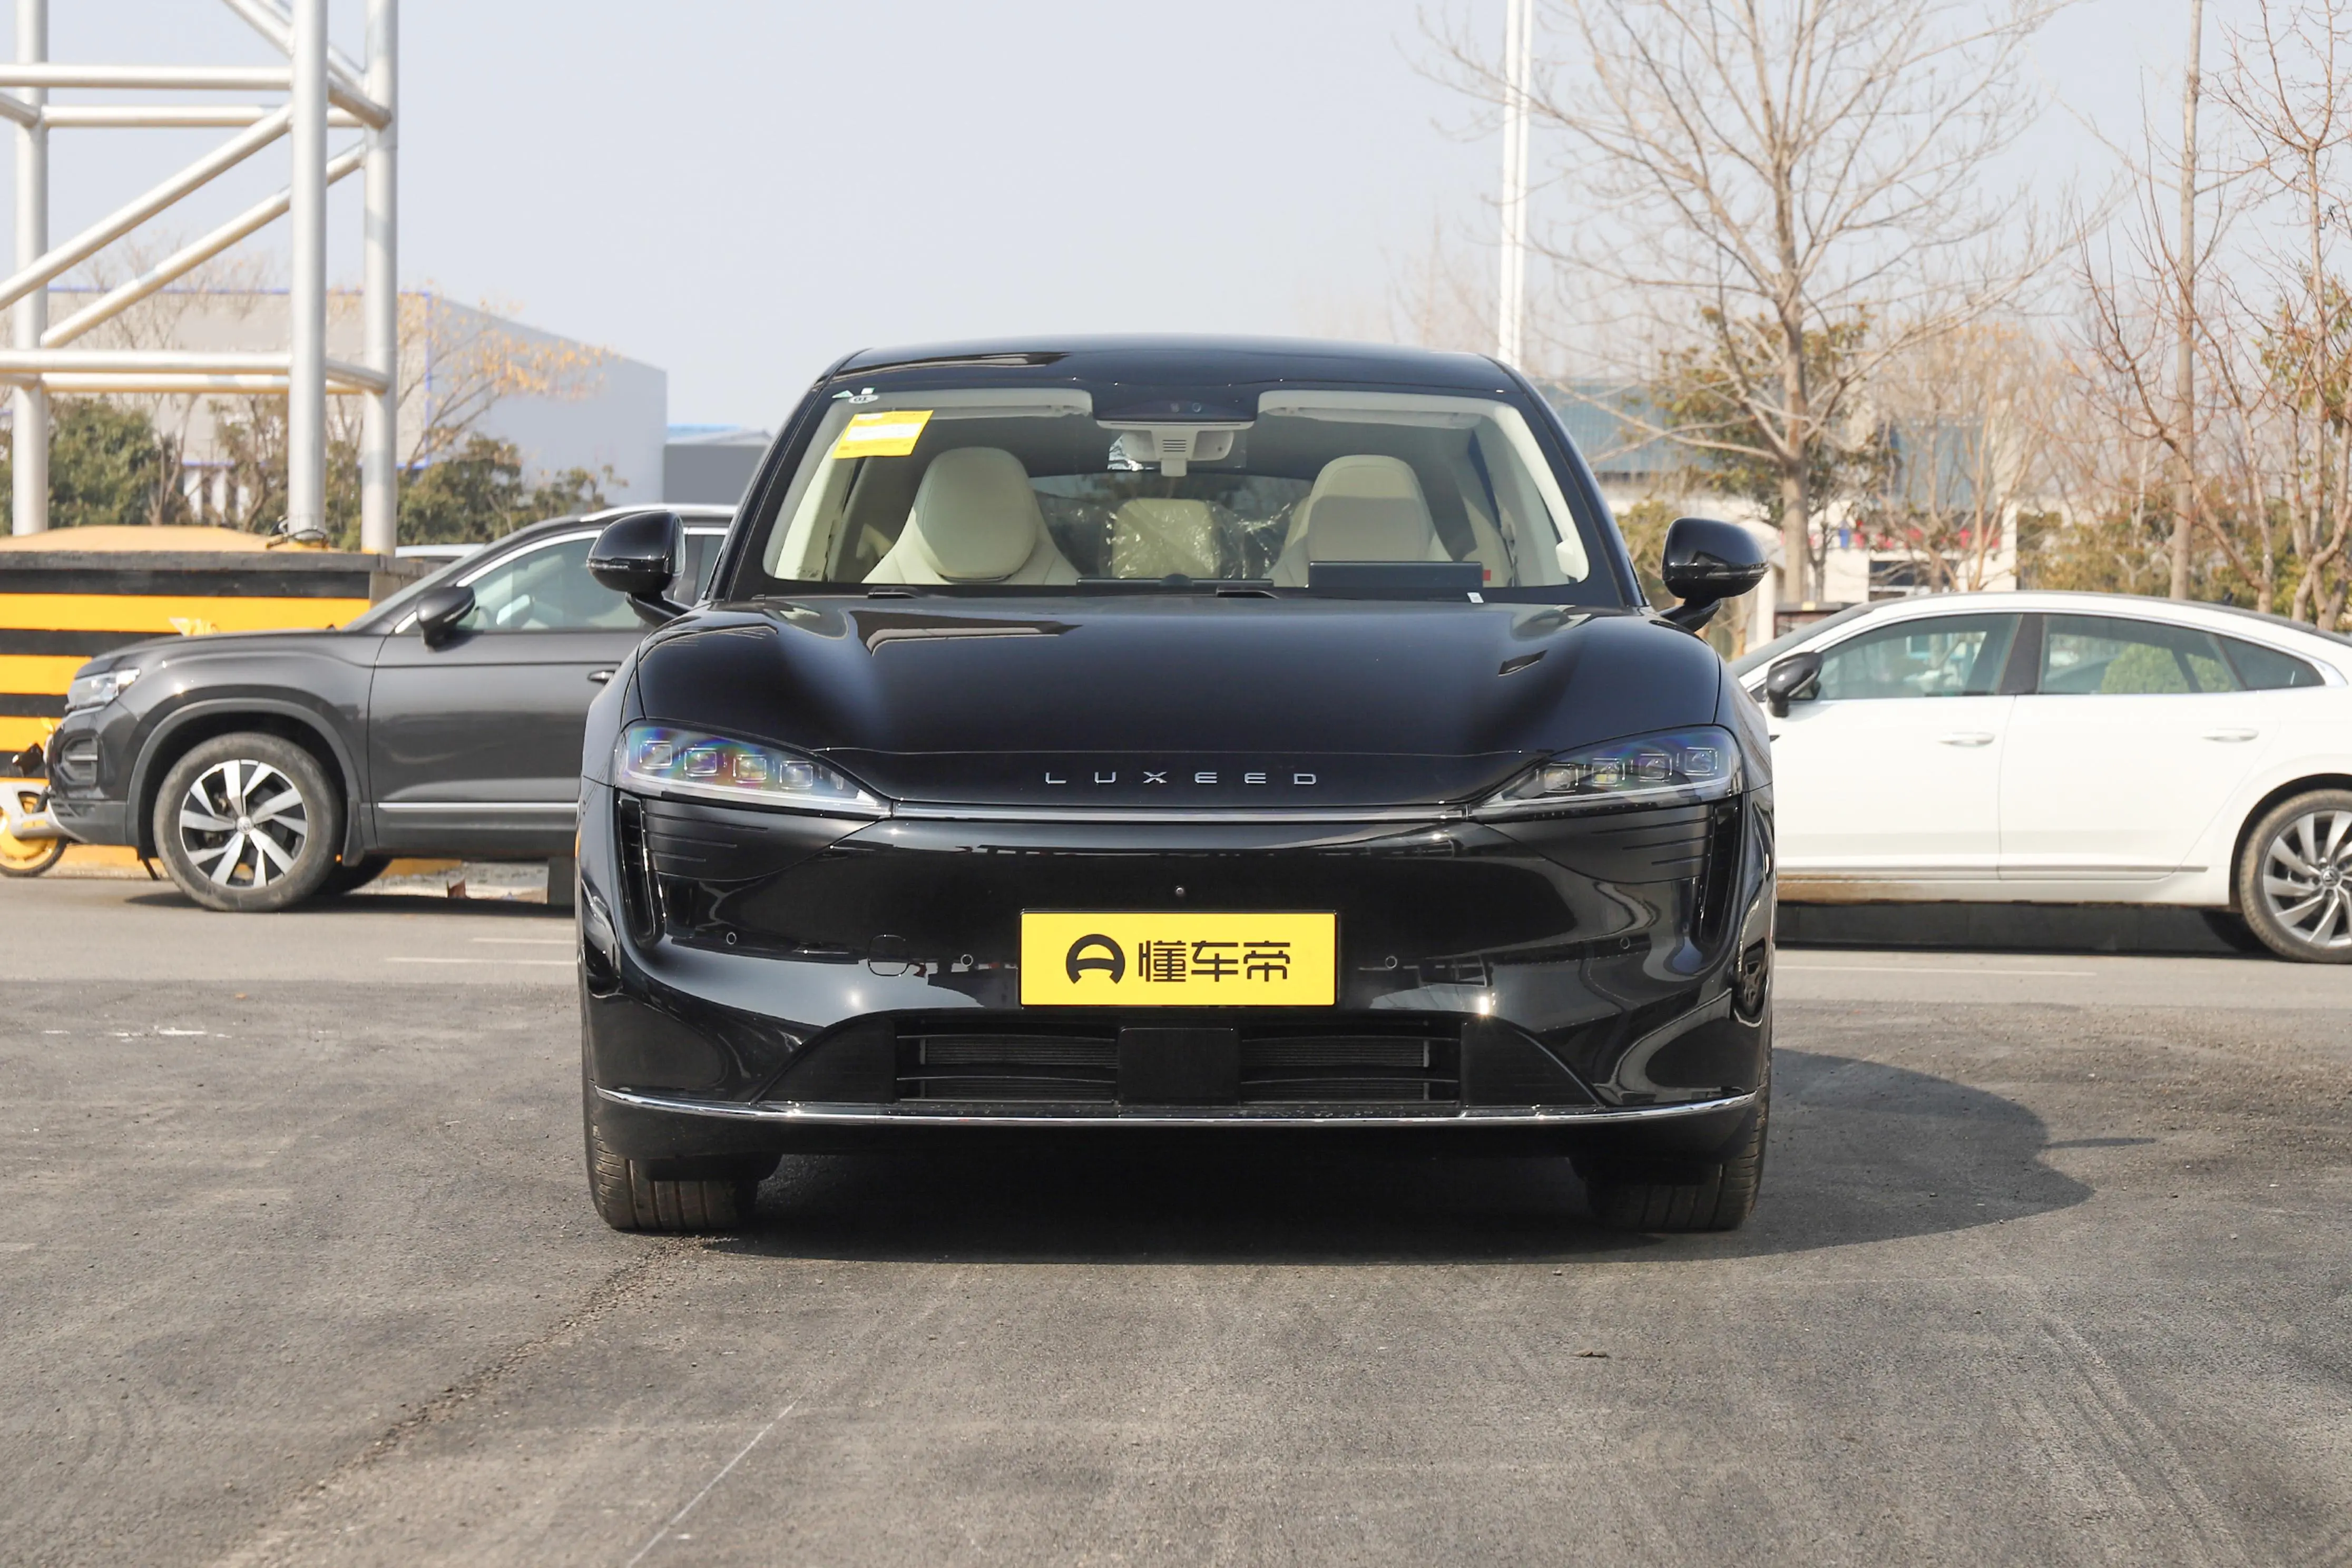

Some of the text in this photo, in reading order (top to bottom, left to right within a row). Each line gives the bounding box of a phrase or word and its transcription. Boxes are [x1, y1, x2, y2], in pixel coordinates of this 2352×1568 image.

[1045, 771, 1317, 785] LUXEED
[1138, 940, 1290, 982] 懂车帝
